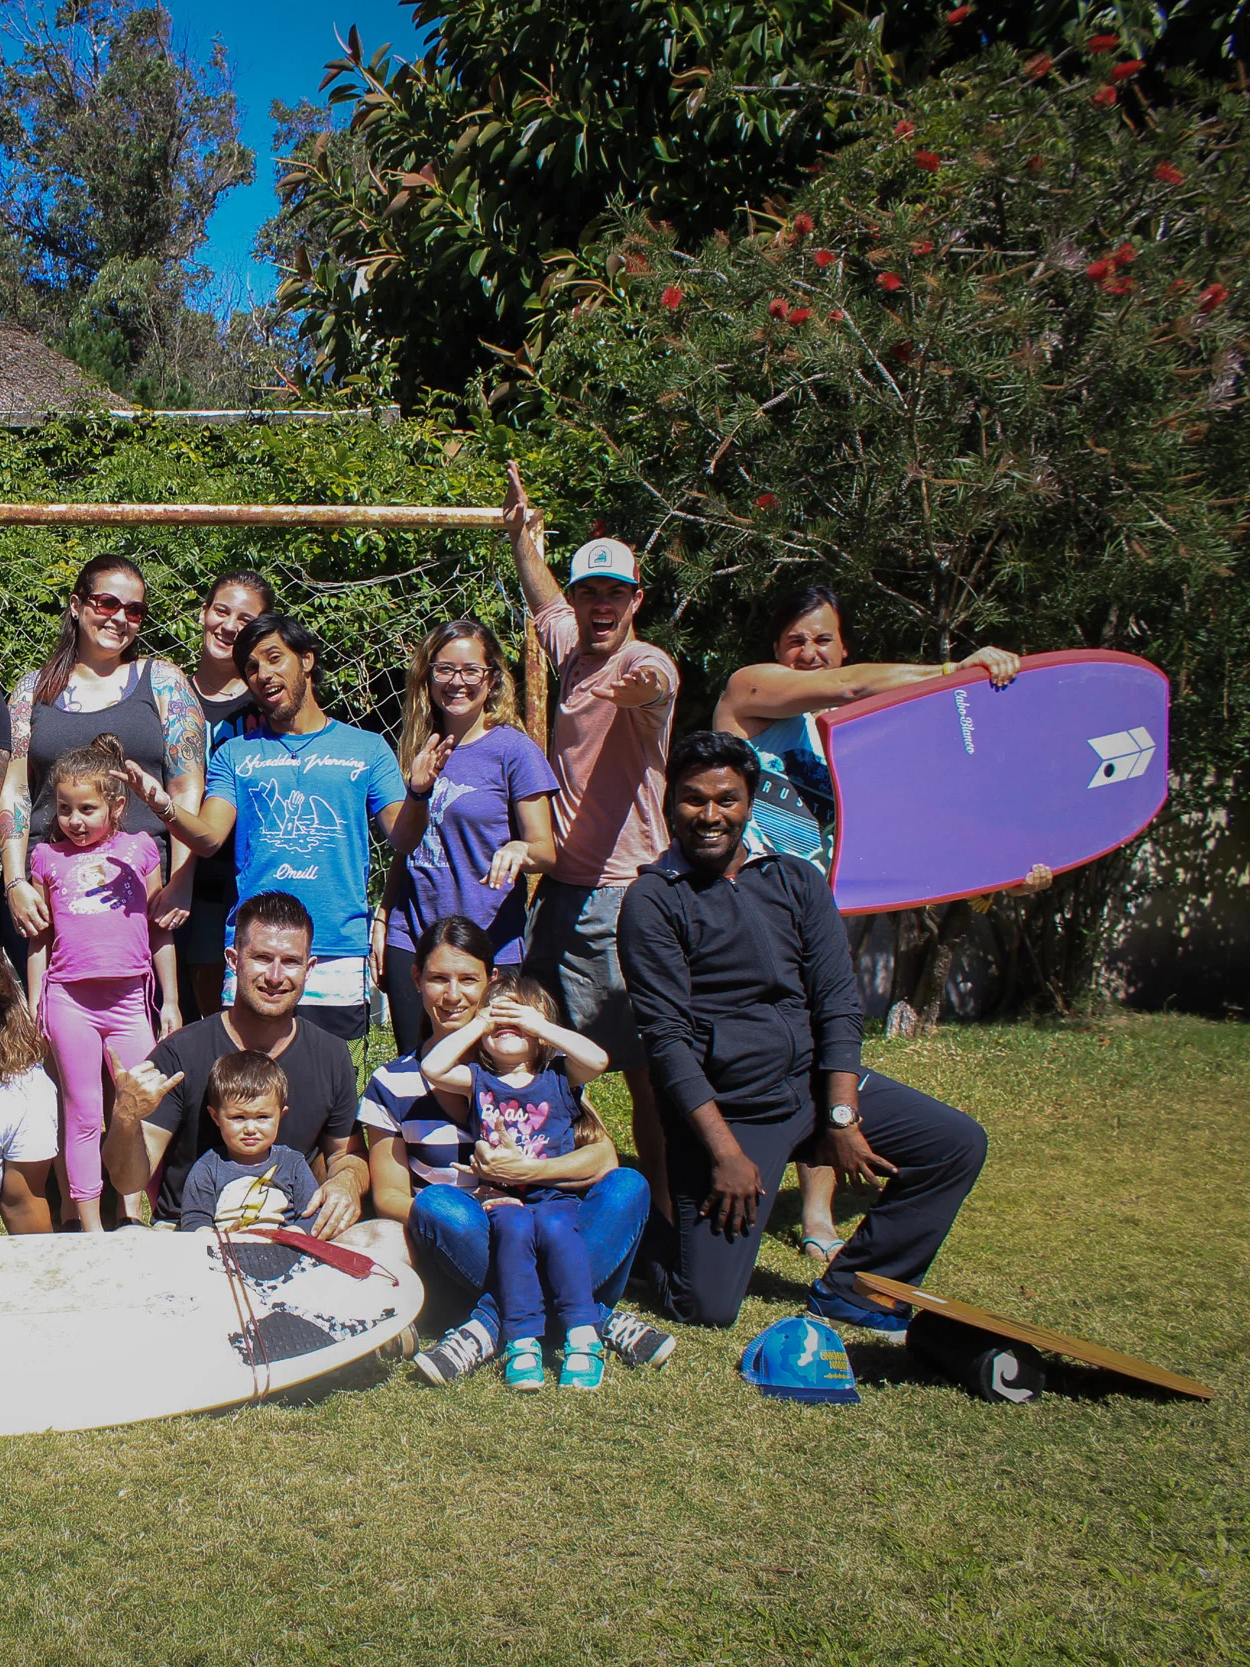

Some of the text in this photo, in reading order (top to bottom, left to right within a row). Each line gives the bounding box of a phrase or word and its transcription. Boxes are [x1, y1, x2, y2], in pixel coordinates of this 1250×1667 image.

[954, 689, 975, 755] Cabo Blanco
[761, 780, 833, 821] RUSTY
[505, 1108, 528, 1122] as
